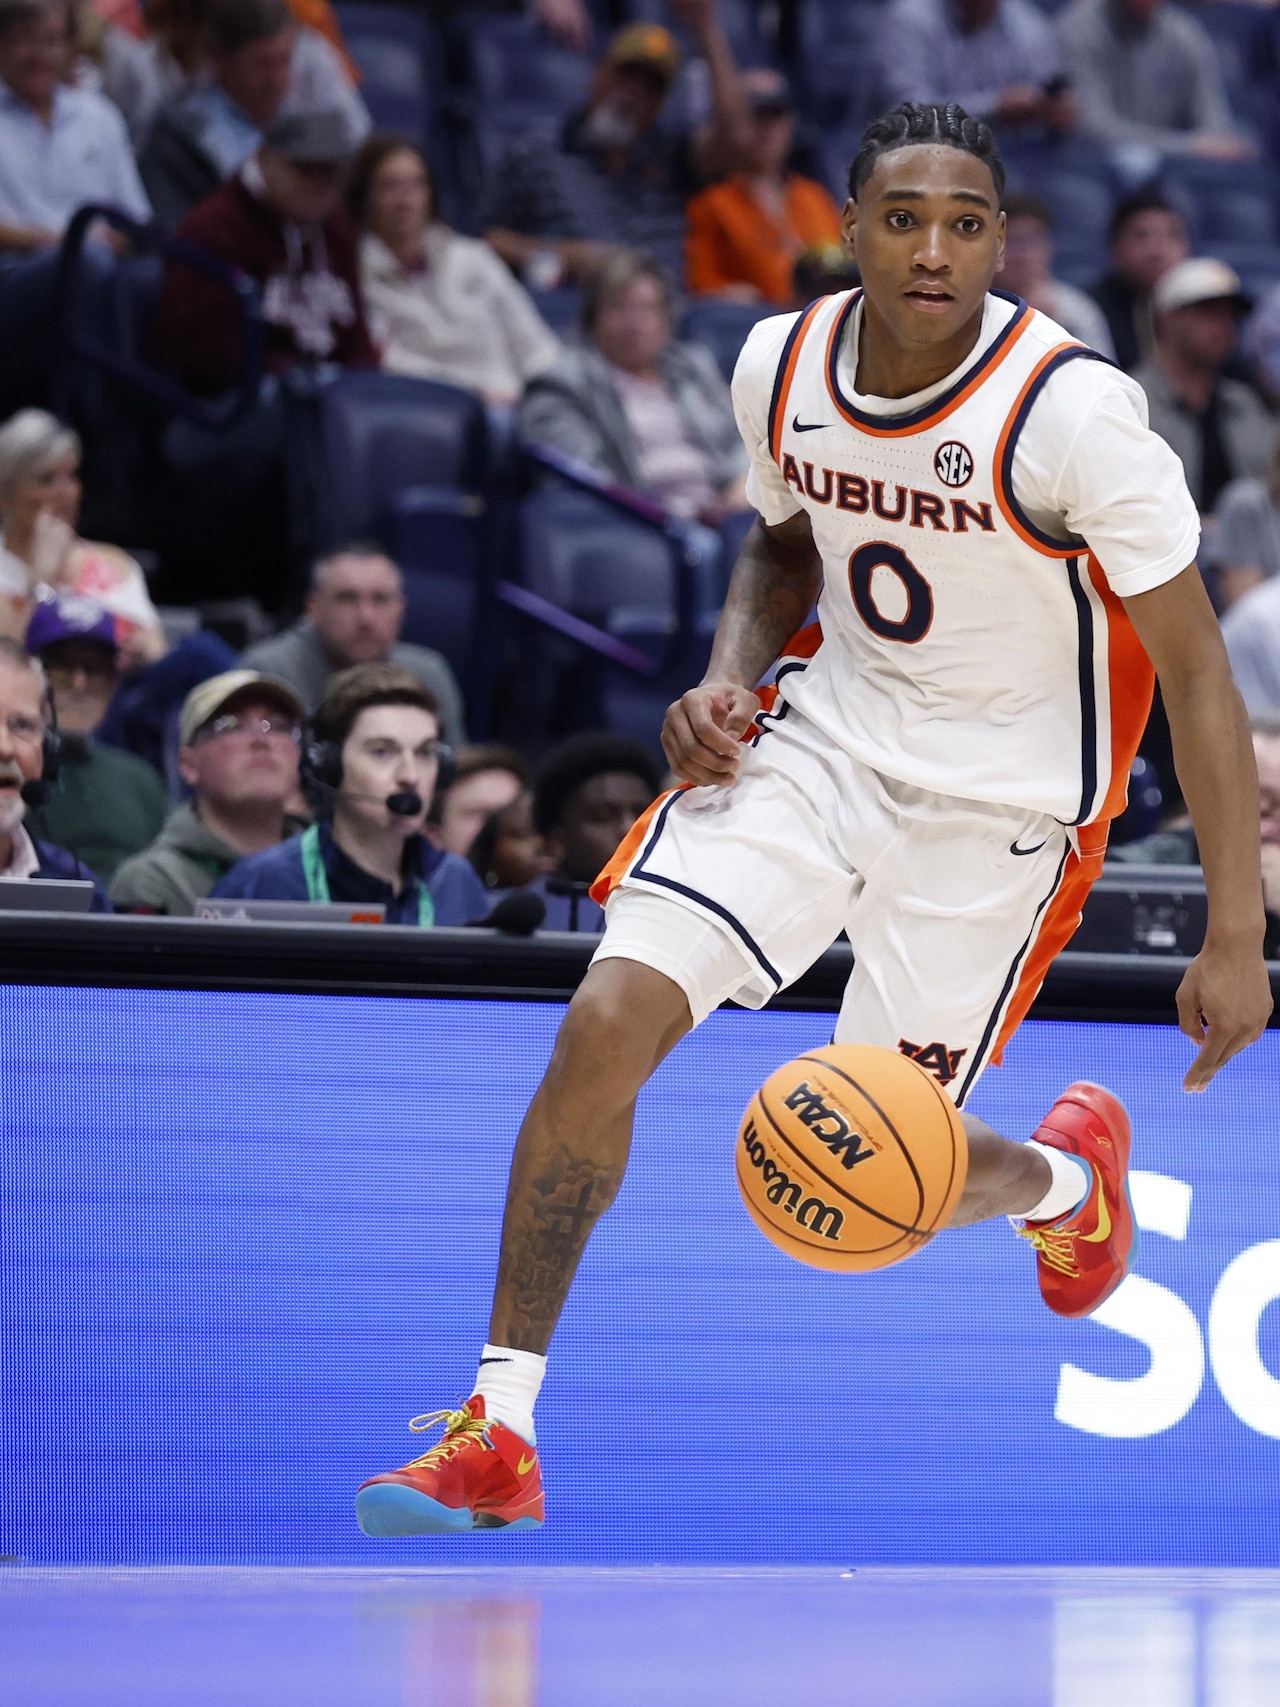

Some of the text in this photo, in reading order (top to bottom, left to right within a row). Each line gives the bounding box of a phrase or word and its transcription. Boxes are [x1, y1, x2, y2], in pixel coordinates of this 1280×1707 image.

[783, 452, 997, 532] AUBURN
[937, 444, 971, 485] SEC
[848, 540, 934, 644] 0
[784, 1080, 874, 1170] NCAA
[743, 1116, 844, 1241] Wilson
